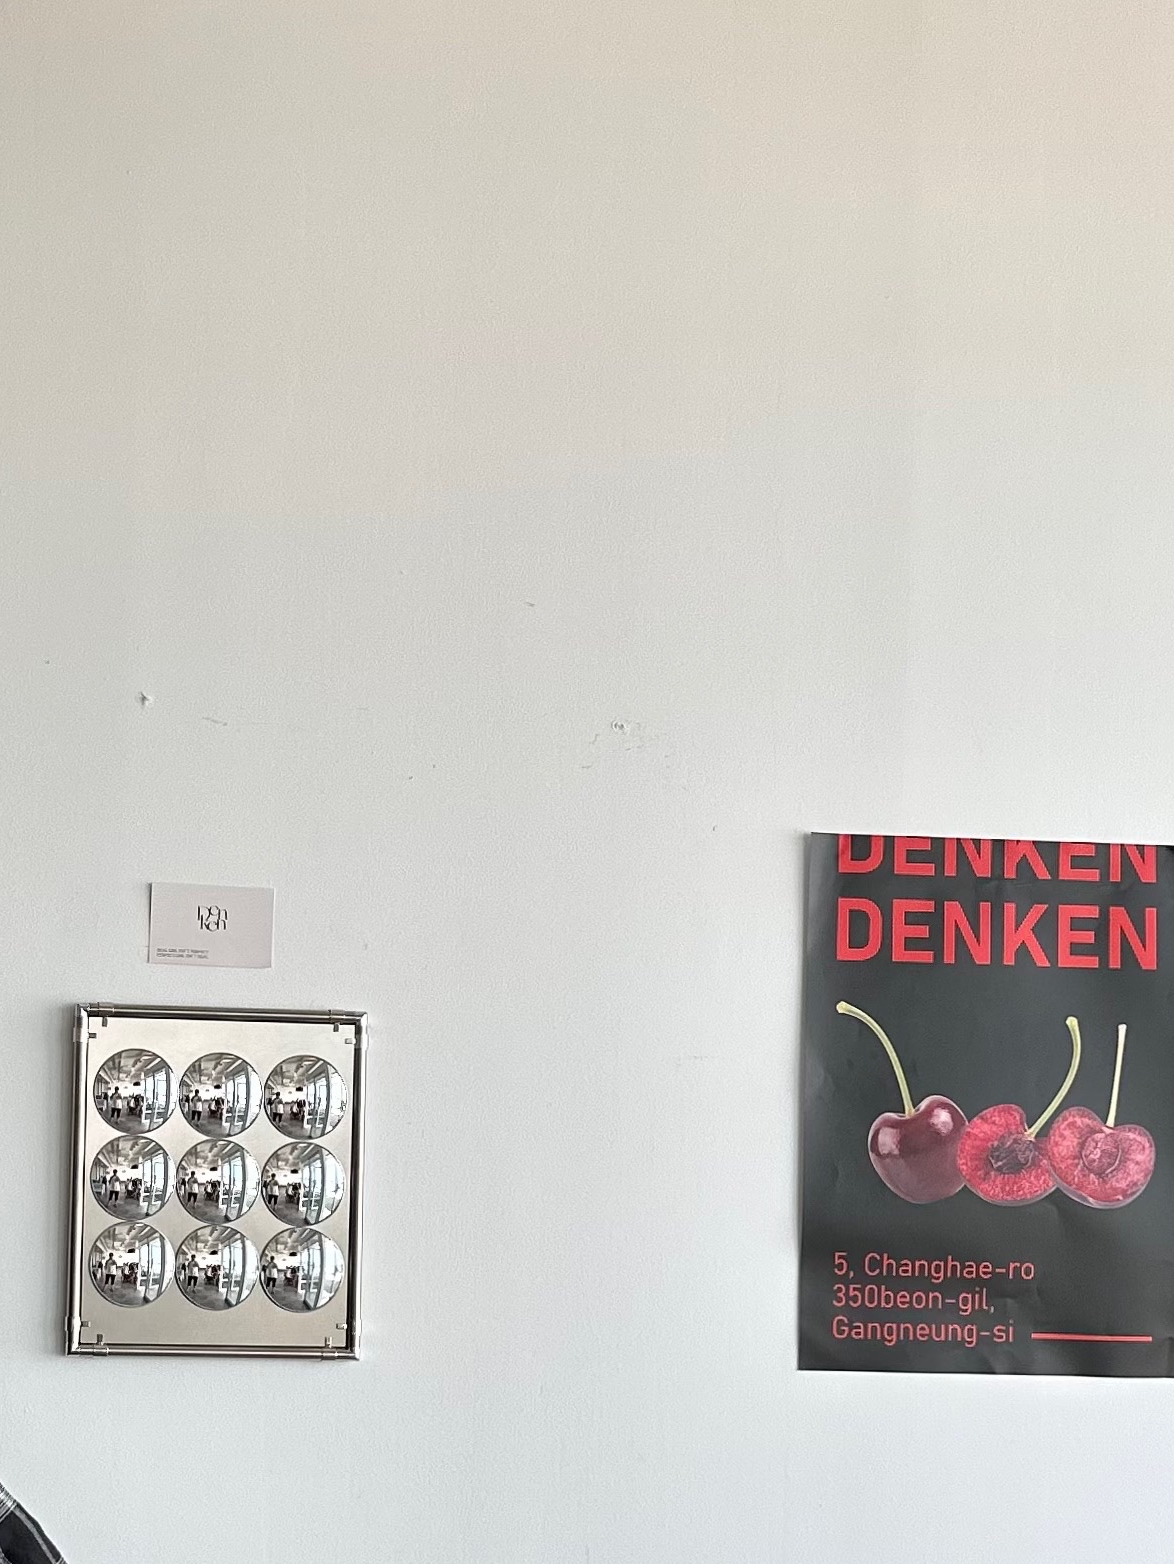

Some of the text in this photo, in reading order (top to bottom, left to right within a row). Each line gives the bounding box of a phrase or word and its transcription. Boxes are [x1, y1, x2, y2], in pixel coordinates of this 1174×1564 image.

[837, 834, 1158, 884] DENKEN
[836, 897, 1158, 970] DENKEN
[833, 1252, 1036, 1284] 5, Changhae-ro
[832, 1284, 996, 1316] 350beon-gil,
[832, 1315, 1015, 1348] Gangneung-si
